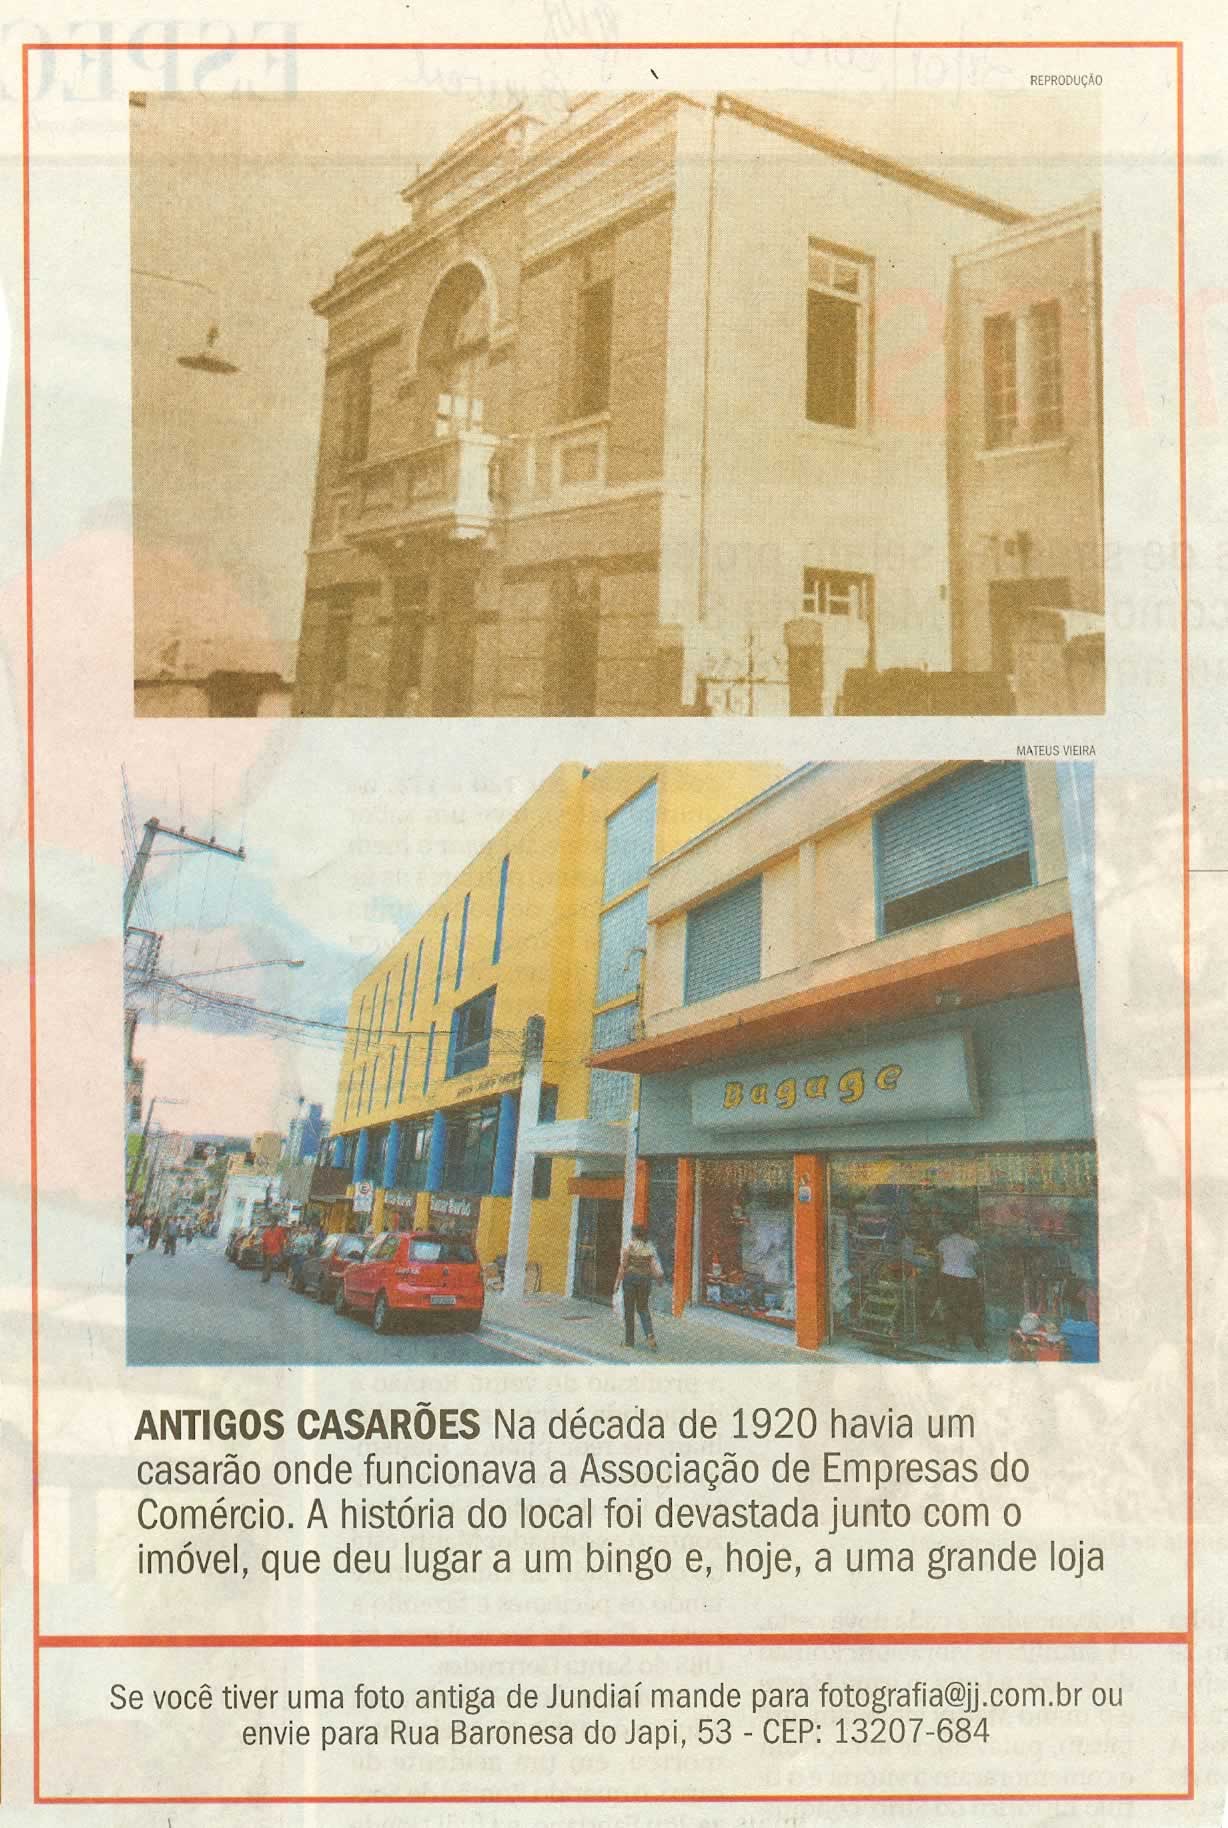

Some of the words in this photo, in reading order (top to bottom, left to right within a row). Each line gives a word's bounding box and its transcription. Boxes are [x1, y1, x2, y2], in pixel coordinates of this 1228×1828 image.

[1030, 74, 1103, 87] REPRODUÇÃO
[1016, 745, 1060, 756] MATEUS
[1064, 745, 1096, 756] VIEIRA
[722, 1064, 904, 1111] Bagage
[134, 1408, 285, 1441] ANTIGOS
[297, 1401, 481, 1441] CASARÕES
[494, 1408, 535, 1440] Na
[548, 1405, 665, 1440] década
[678, 1407, 718, 1440] de
[732, 1407, 817, 1440] 1920
[831, 1407, 913, 1439] havia
[928, 1414, 975, 1439] um
[137, 1453, 261, 1486] casarão
[273, 1453, 353, 1485] onde
[363, 1452, 536, 1485] funcionava
[549, 1460, 567, 1485] a
[579, 1451, 759, 1492] Associação
[771, 1452, 810, 1484] de
[823, 1451, 978, 1491] Empresas
[990, 1451, 1029, 1483] do
[137, 1496, 294, 1530] Comércio.
[306, 1498, 328, 1529] A
[341, 1495, 454, 1530] história
[467, 1497, 507, 1529] do
[520, 1497, 592, 1529] local
[604, 1496, 642, 1529] foi
[655, 1496, 819, 1529] devastada
[828, 1496, 911, 1535] junto
[924, 1503, 989, 1528] com
[1003, 1503, 1022, 1528] o
[138, 1540, 248, 1580] imóvel,
[261, 1549, 321, 1581] que
[333, 1542, 391, 1574] deu
[404, 1542, 483, 1582] lugar
[492, 1549, 511, 1574] a
[525, 1549, 572, 1574] um
[586, 1541, 672, 1581] bingo
[685, 1548, 712, 1578] e,
[726, 1541, 801, 1580] hoje,
[814, 1548, 832, 1573] a
[846, 1548, 914, 1573] uma
[927, 1540, 1037, 1580] grande
[1050, 1540, 1104, 1579] loja
[110, 1683, 144, 1710] Se
[153, 1683, 213, 1710] você
[221, 1683, 279, 1710] tiver
[288, 1689, 344, 1710] uma
[354, 1683, 405, 1710] foto
[415, 1683, 495, 1716] antiga
[506, 1683, 539, 1709] de
[546, 1681, 642, 1709] Jundiaí
[651, 1682, 741, 1709] mande
[752, 1688, 809, 1714] para
[818, 1681, 1083, 1714] fotografia@jj.com.br
[1092, 1687, 1123, 1707] ou
[242, 1720, 310, 1746] envie
[321, 1725, 378, 1751] para
[391, 1719, 439, 1745] Rua
[451, 1719, 573, 1745] Baronesa
[584, 1719, 617, 1745] do
[625, 1719, 686, 1750] Japi,
[698, 1718, 732, 1745] 53
[763, 1718, 821, 1745] CEP:
[835, 1717, 990, 1744] 13207-684
